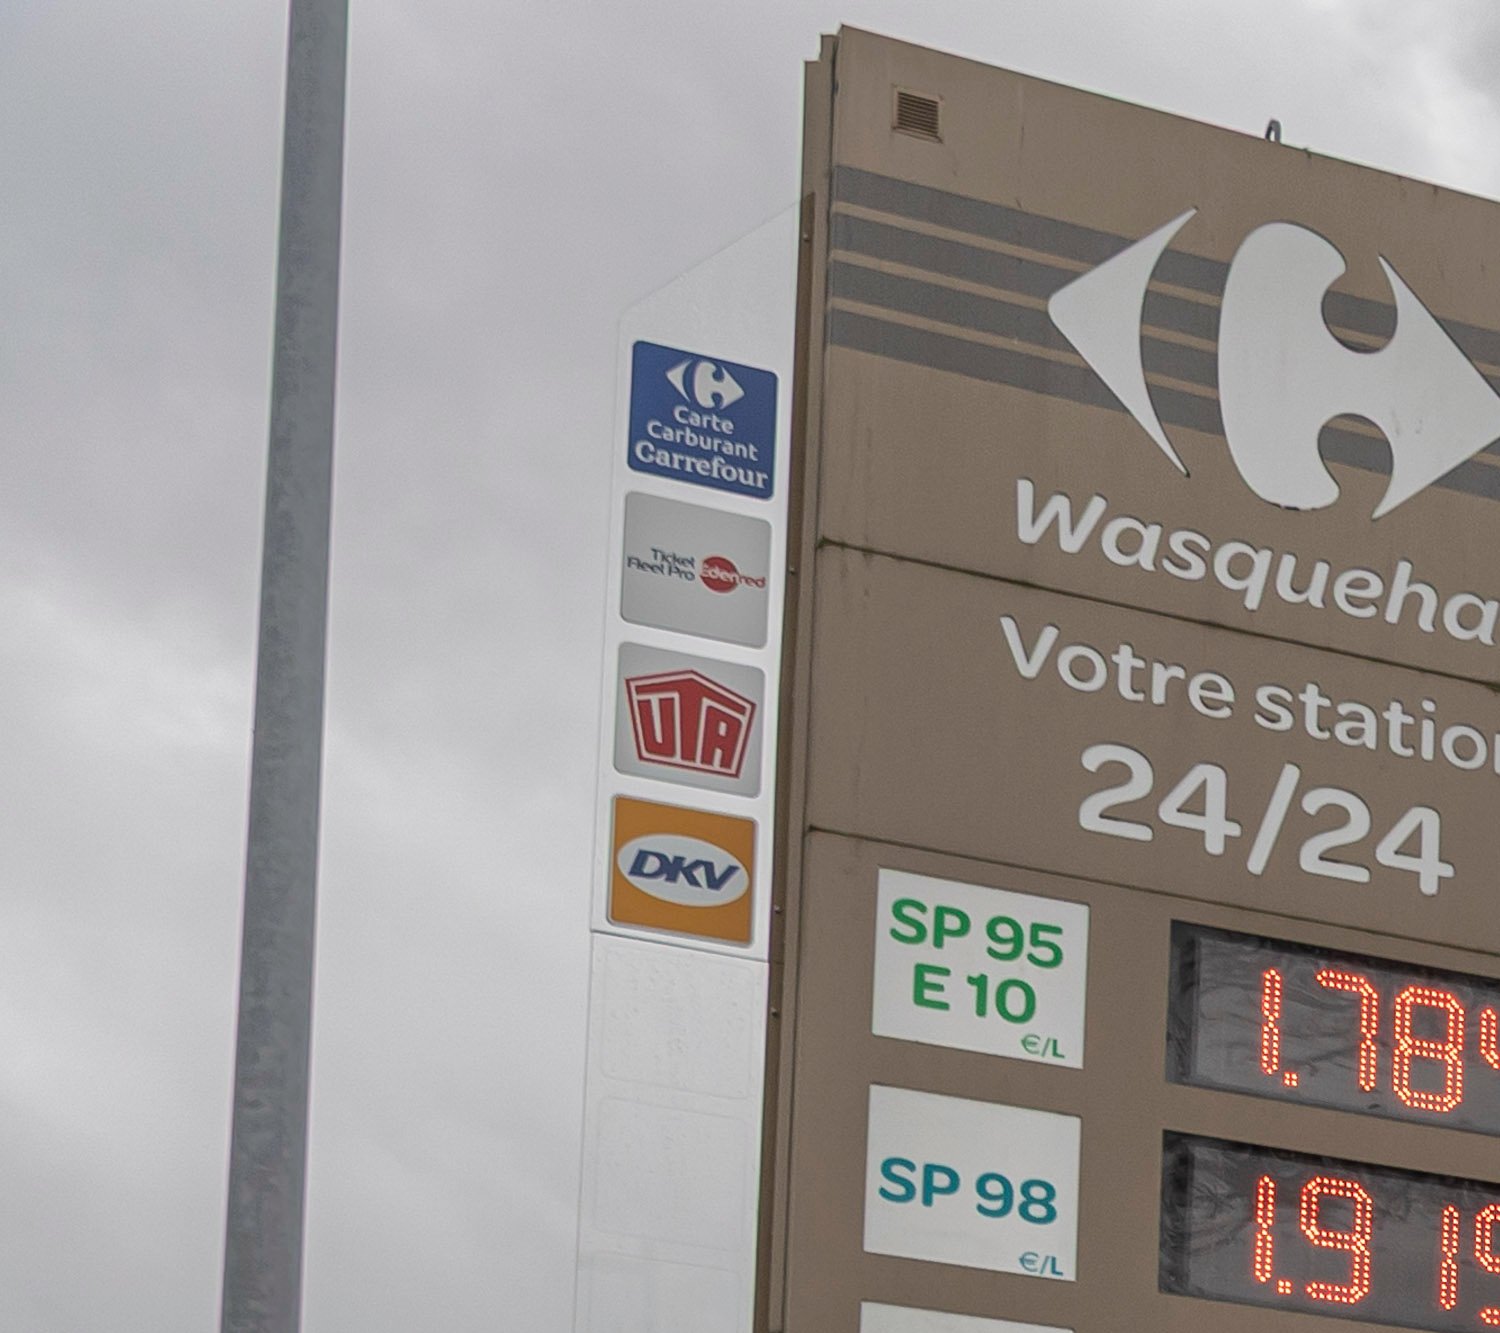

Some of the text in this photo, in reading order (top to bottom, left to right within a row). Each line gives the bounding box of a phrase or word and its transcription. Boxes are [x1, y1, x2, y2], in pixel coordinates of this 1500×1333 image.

[647, 419, 759, 462] Carburant
[673, 405, 734, 434] Carte
[635, 440, 769, 489] Carrefour
[651, 547, 695, 569] Ticket
[667, 563, 695, 582] Pro
[700, 563, 766, 588] Edenred
[1000, 616, 1235, 718] Votre
[625, 670, 756, 779] UTA
[1079, 743, 1456, 895] 24/24
[628, 848, 740, 891] DKV
[889, 897, 1064, 970] SP 95
[912, 962, 1037, 1025] E 10
[1020, 1032, 1066, 1060] €/L
[877, 1156, 1058, 1226] SP 98
[1017, 1251, 1064, 1278] €/L
